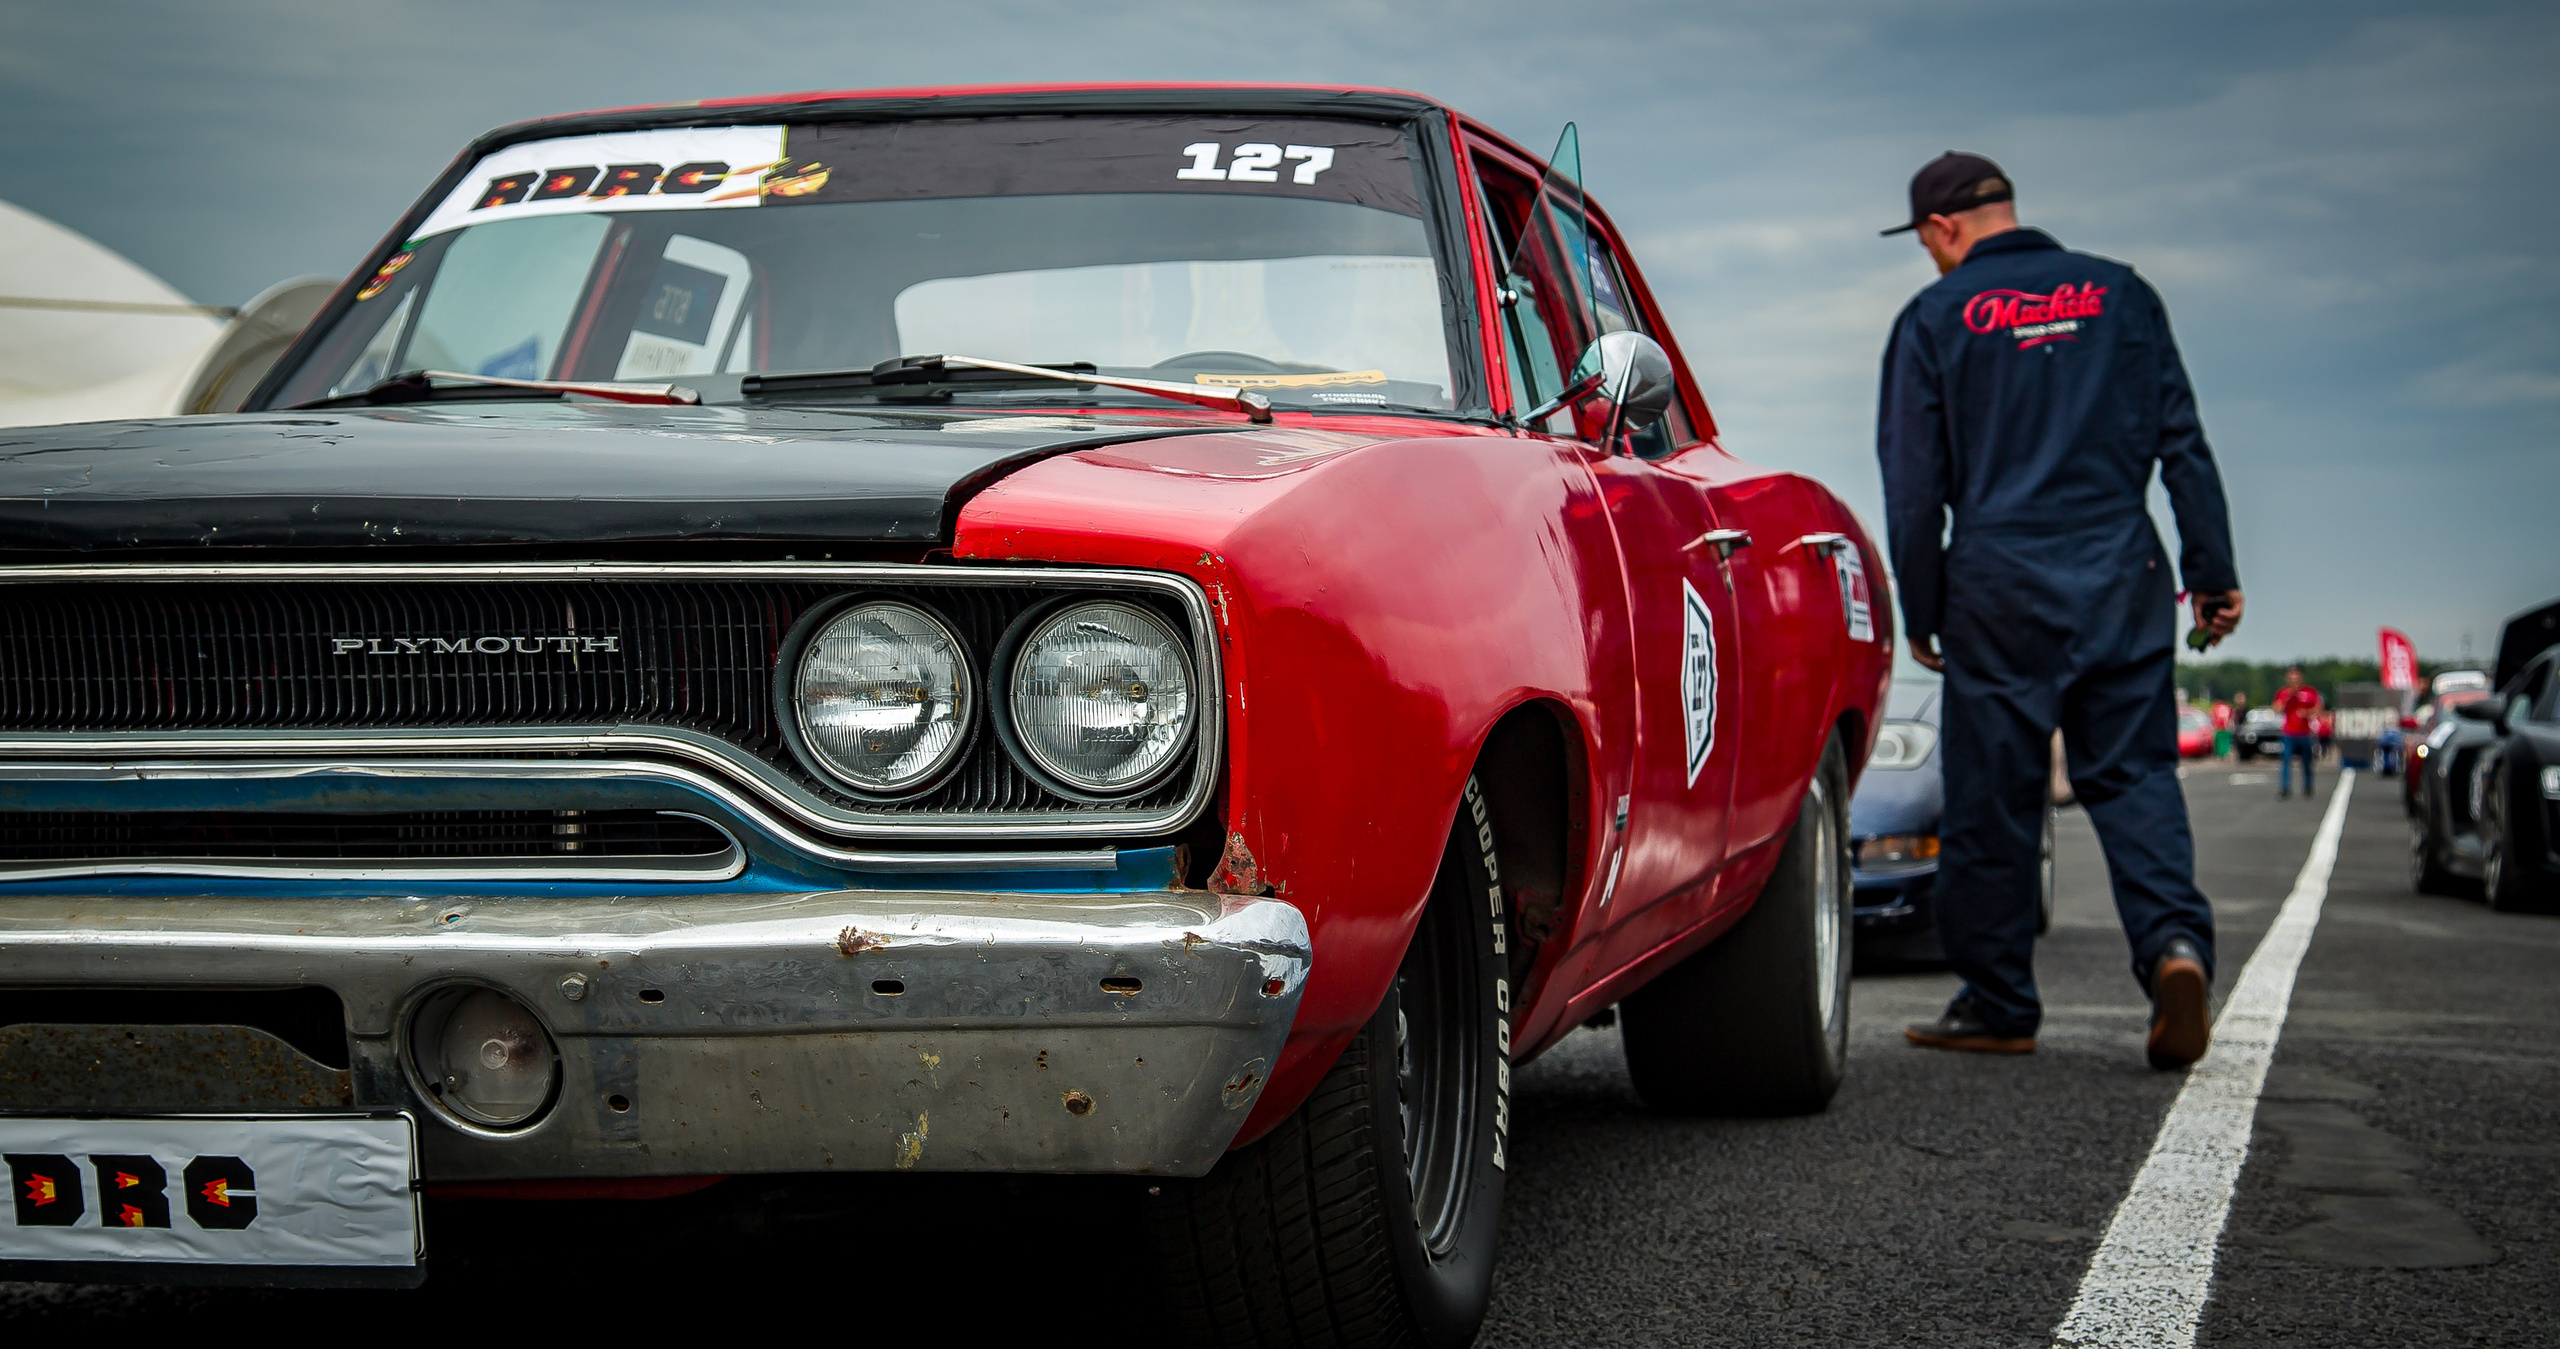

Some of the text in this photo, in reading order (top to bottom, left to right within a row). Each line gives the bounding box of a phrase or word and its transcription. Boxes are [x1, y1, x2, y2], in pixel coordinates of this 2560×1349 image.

[467, 161, 731, 211] RDRC
[1176, 142, 1335, 185] 127
[332, 635, 619, 654] PLYMOUTH
[1463, 773, 1510, 1172] COOPER COBRA
